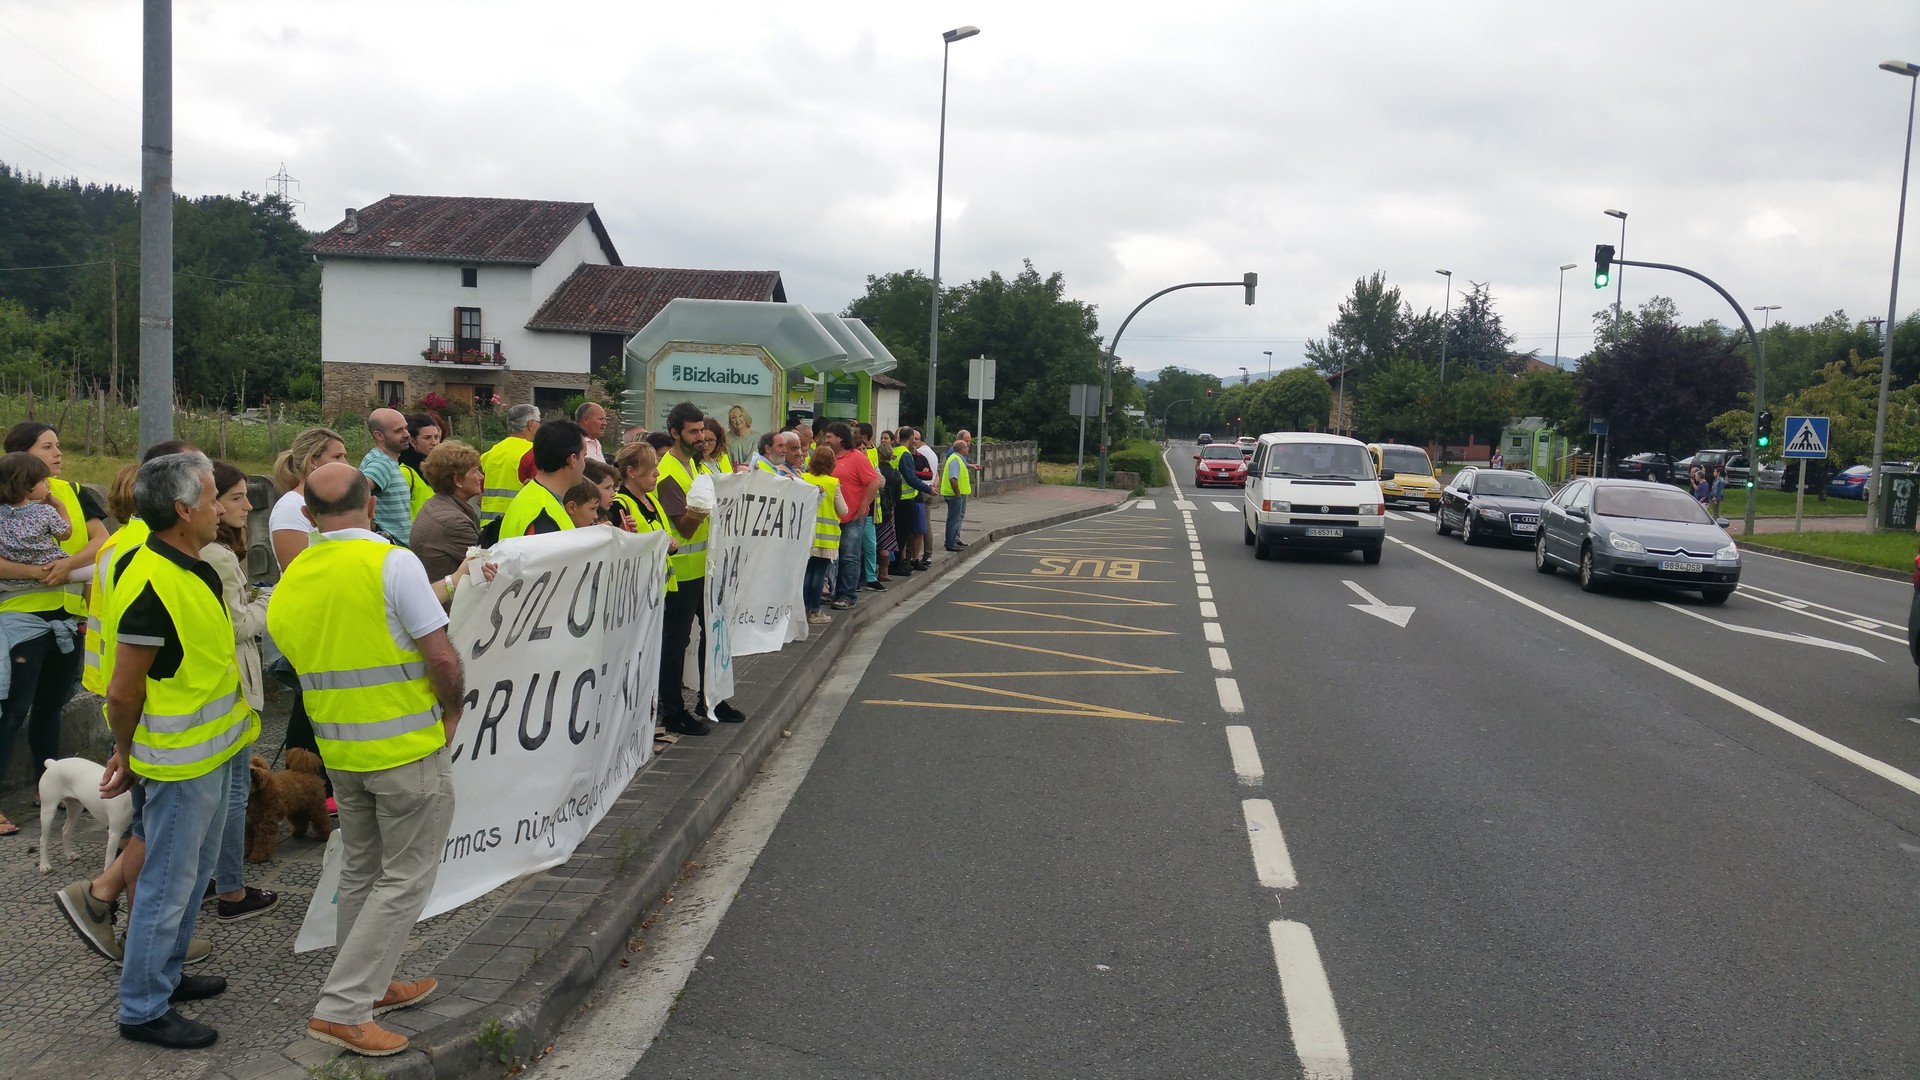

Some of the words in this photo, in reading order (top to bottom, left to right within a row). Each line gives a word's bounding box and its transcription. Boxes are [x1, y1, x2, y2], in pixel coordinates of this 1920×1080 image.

[683, 366, 759, 385] Bizkaibus
[1031, 557, 1140, 580] BUS
[739, 608, 756, 625] eta
[439, 826, 502, 864] rmas
